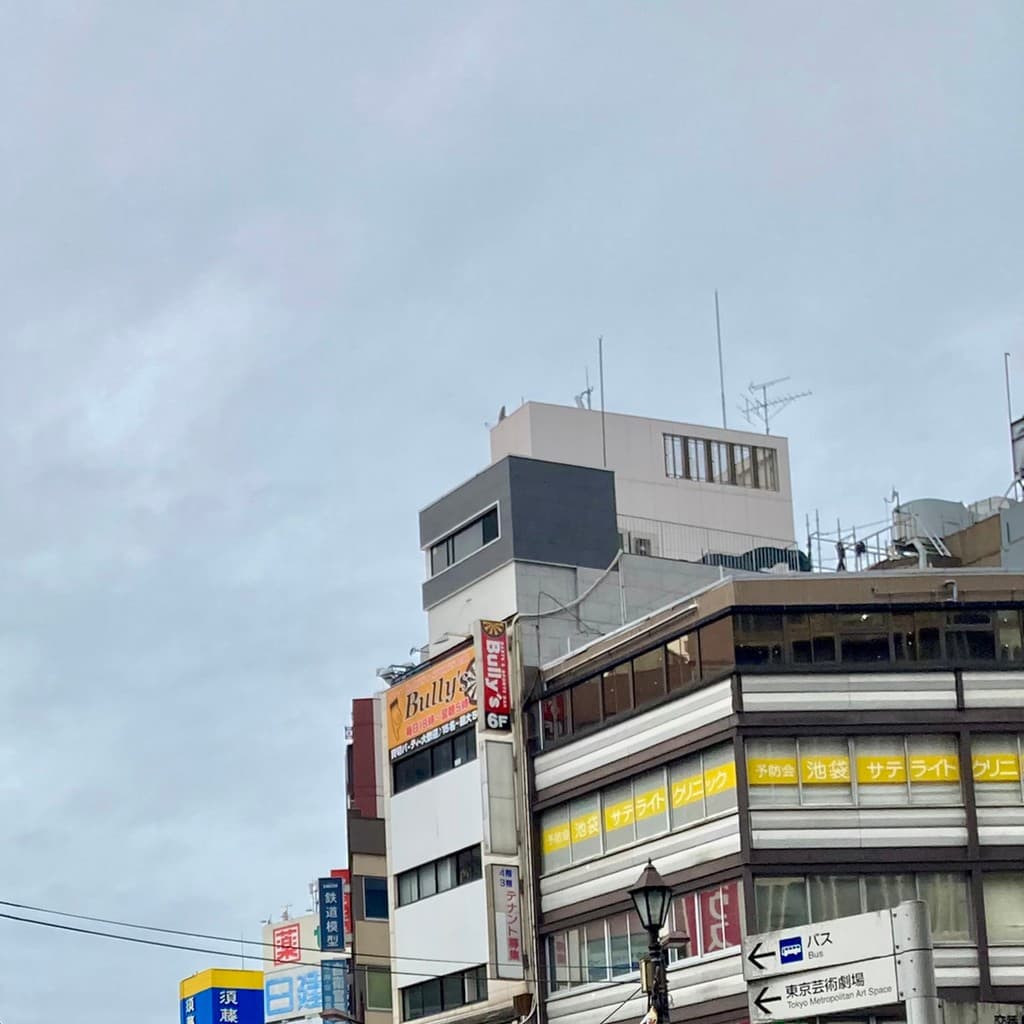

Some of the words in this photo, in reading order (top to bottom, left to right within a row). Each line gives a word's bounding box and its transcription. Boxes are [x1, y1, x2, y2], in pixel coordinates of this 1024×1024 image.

[485, 639, 502, 708] Bully's
[404, 672, 469, 720] Bully's
[487, 711, 508, 730] 6F
[755, 764, 796, 778] 予防会
[806, 761, 850, 780] 池袋
[866, 760, 958, 778] サテライト
[972, 760, 1018, 777] クリニ
[610, 793, 666, 819] サテライト
[673, 772, 728, 804] クリニック
[325, 891, 338, 947] 鉄道模型
[276, 930, 297, 960] 薬
[806, 931, 833, 947] バス
[807, 949, 824, 959] Bus
[785, 972, 865, 999] 東京芸術劇場
[787, 998, 809, 1009] Tokyo
[810, 991, 852, 1006] Metropolitan
[855, 988, 868, 998] Art
[870, 985, 893, 998] Space
